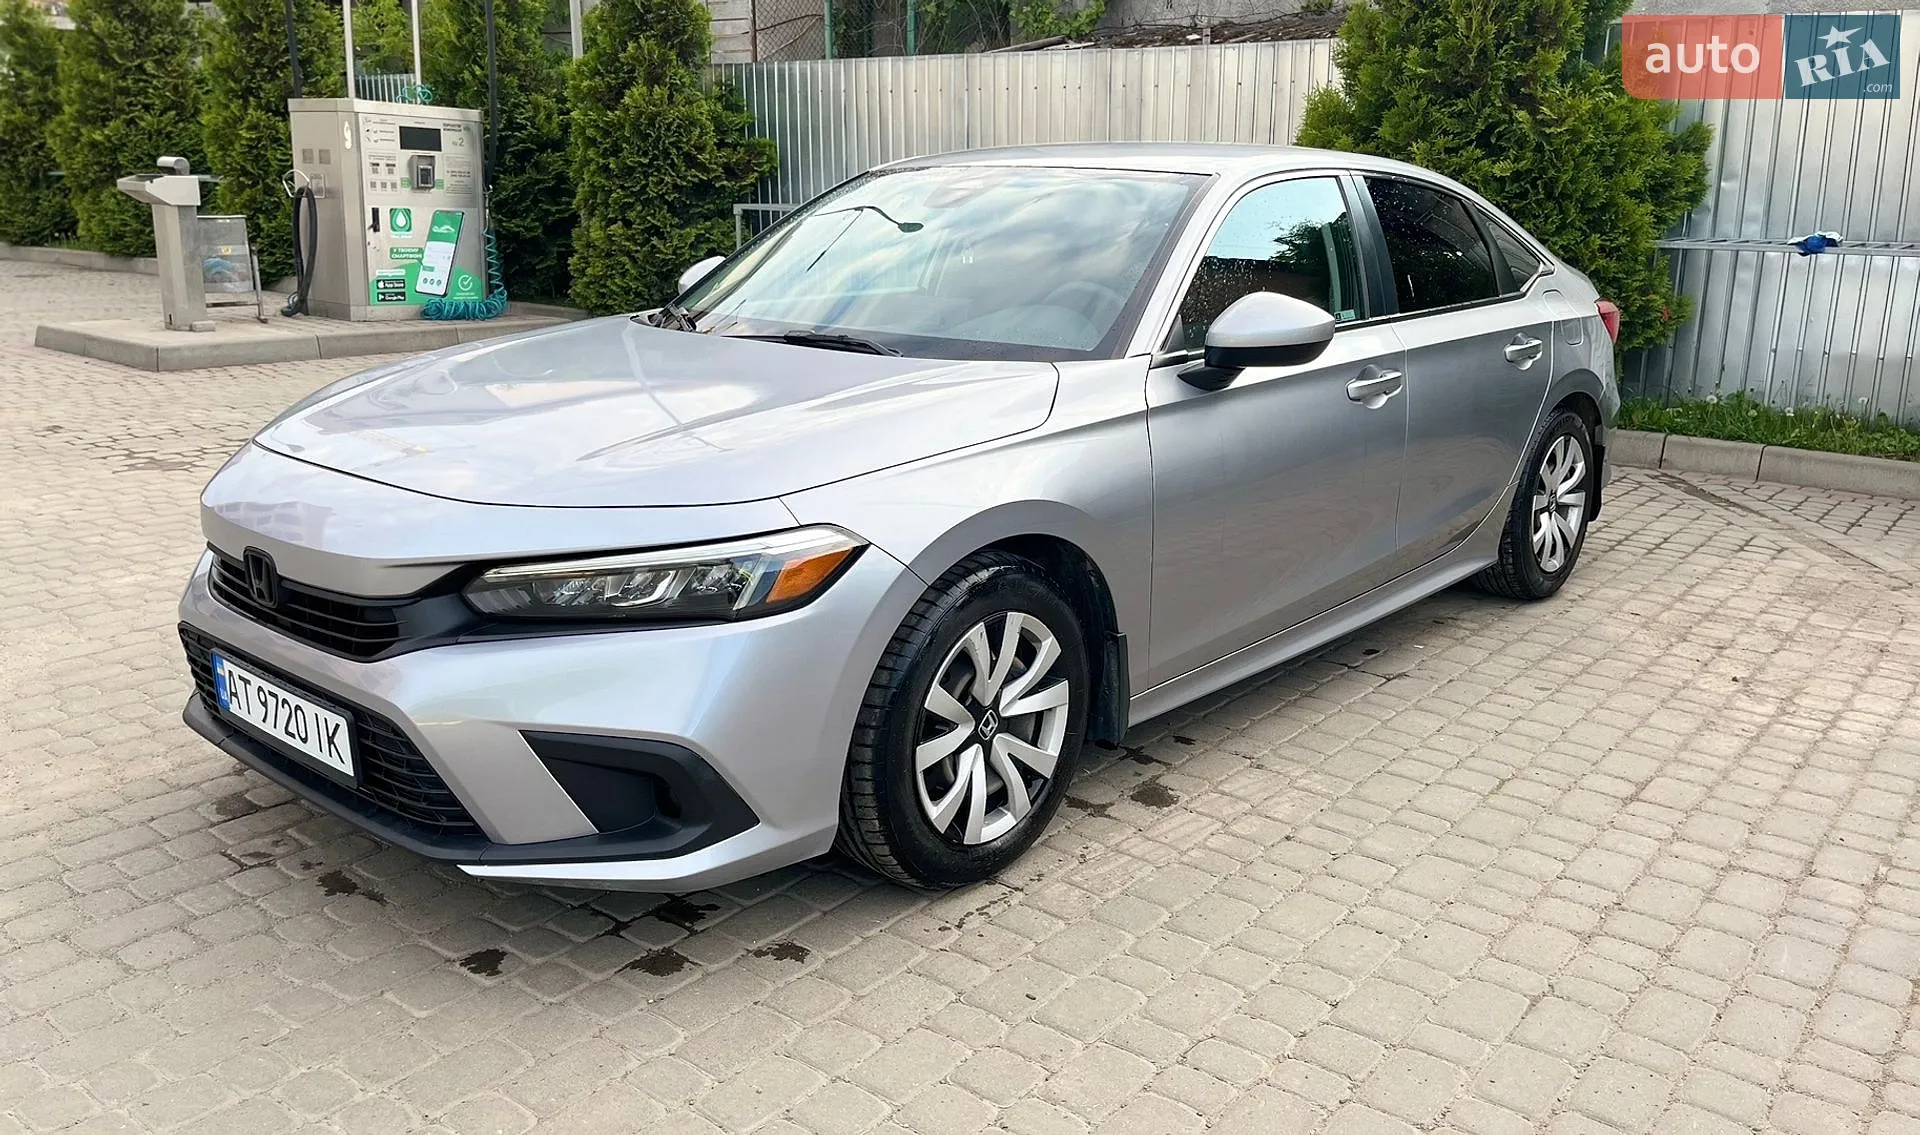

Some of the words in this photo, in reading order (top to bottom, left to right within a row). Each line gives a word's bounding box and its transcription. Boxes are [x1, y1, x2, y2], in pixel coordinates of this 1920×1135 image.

[227, 669, 251, 715] AT
[257, 685, 309, 745] 9720
[314, 712, 345, 765] IK
